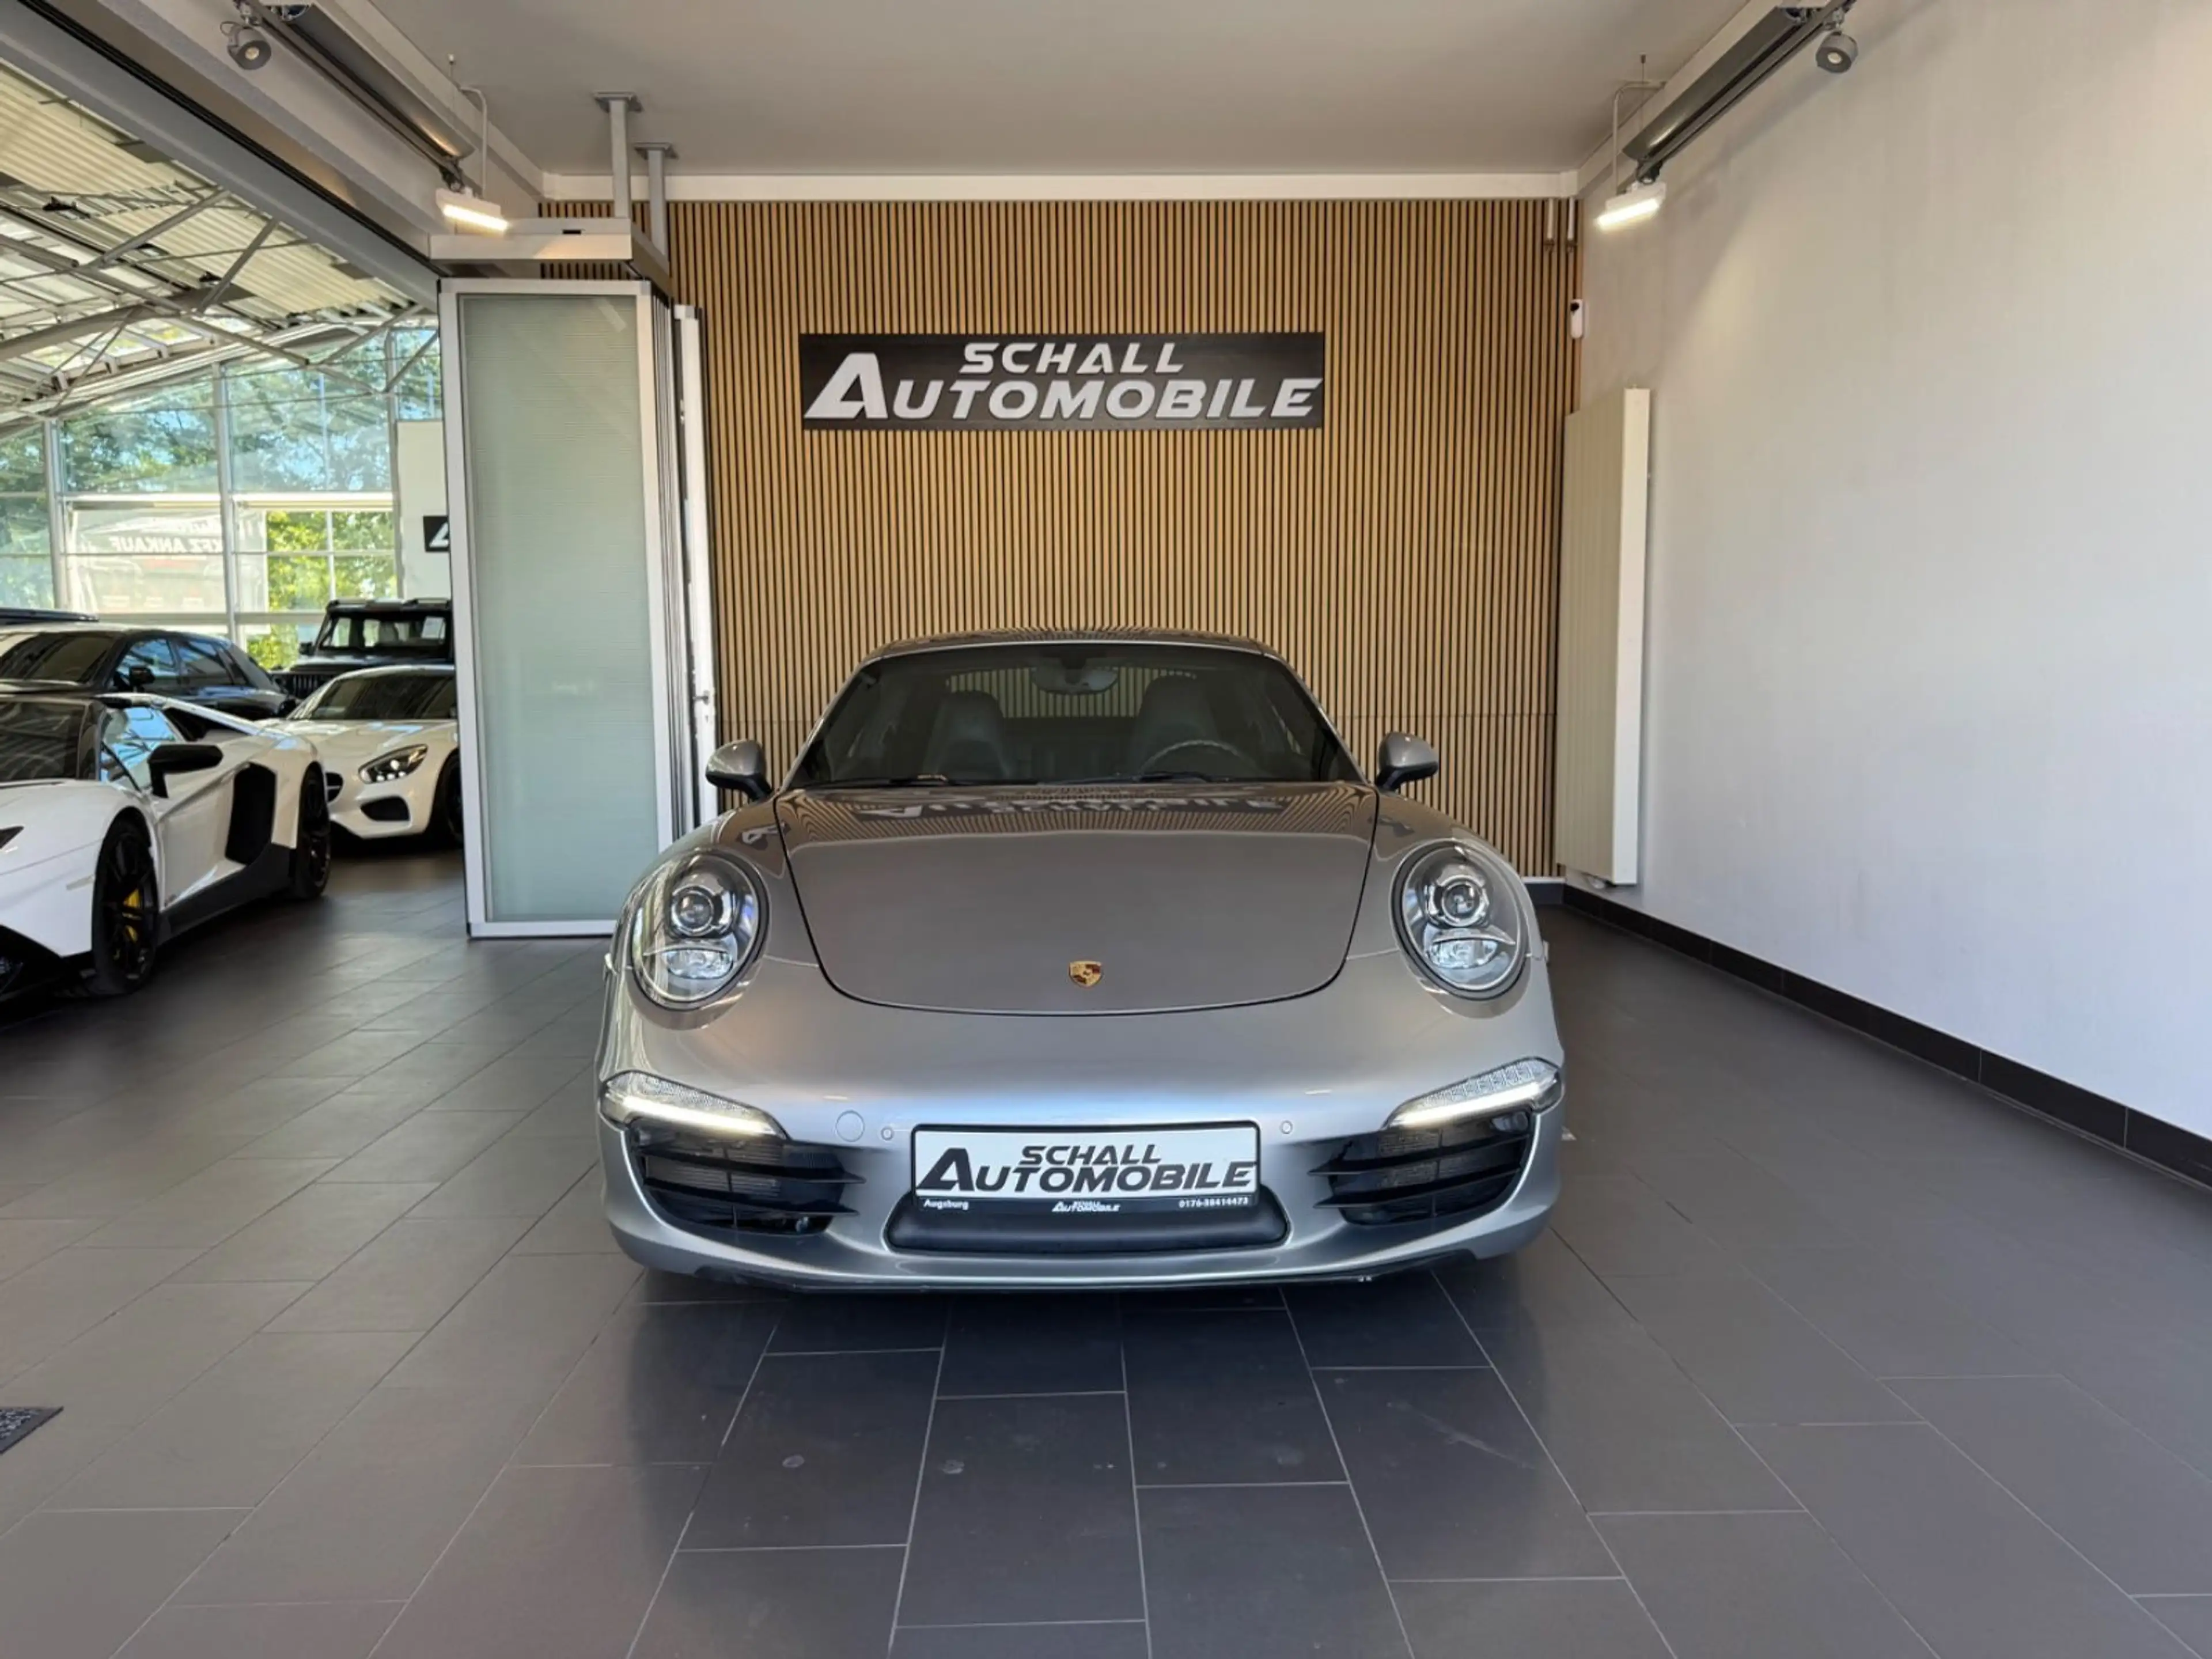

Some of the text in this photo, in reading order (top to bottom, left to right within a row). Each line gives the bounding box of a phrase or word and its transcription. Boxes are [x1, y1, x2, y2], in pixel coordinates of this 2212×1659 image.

[959, 342, 1184, 374] SCHALL
[805, 353, 1324, 420] AUTOMOBILE
[916, 1148, 1256, 1192] AUTOMOBILE
[1019, 1143, 1162, 1165] SCHALL
[923, 1199, 969, 1210] Augsburg
